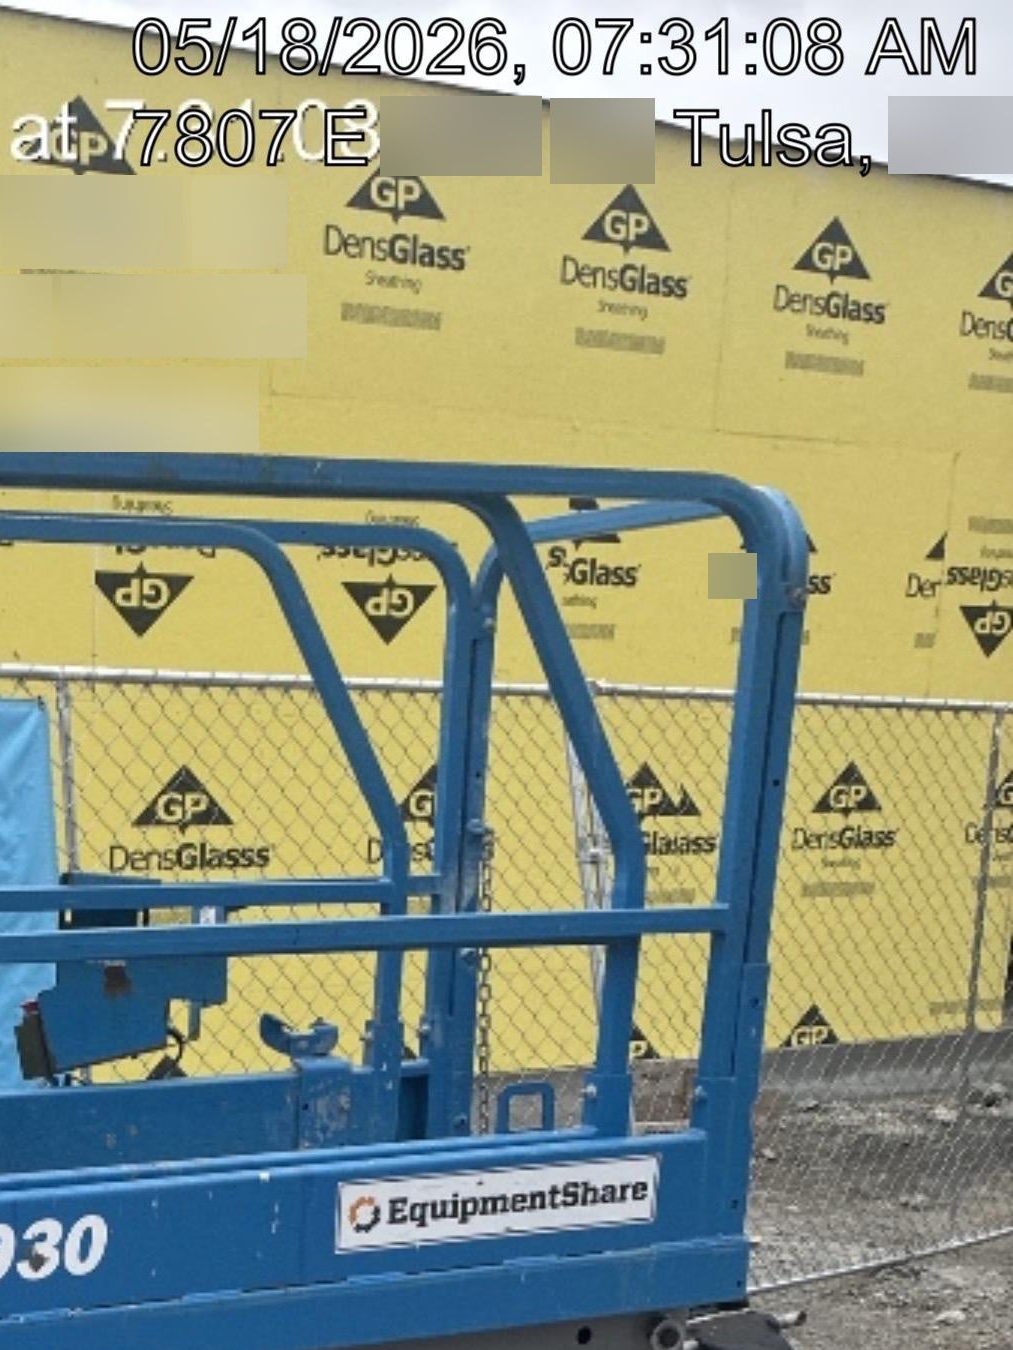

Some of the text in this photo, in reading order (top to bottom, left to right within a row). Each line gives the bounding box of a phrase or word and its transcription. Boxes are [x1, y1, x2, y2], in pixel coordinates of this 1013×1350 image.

[370, 175, 421, 211] GP
[603, 209, 650, 241] GP
[323, 223, 468, 272] DensGlass
[811, 242, 854, 272] GP
[560, 254, 688, 300] DensGlass
[773, 283, 887, 325] DensGlass
[115, 576, 170, 609] GP
[365, 587, 415, 618] GP
[974, 610, 1012, 636] GP
[157, 791, 209, 822] GP
[829, 785, 867, 809] GP
[791, 825, 897, 850] DensGlass
[387, 1180, 648, 1227] EquipmentShare
